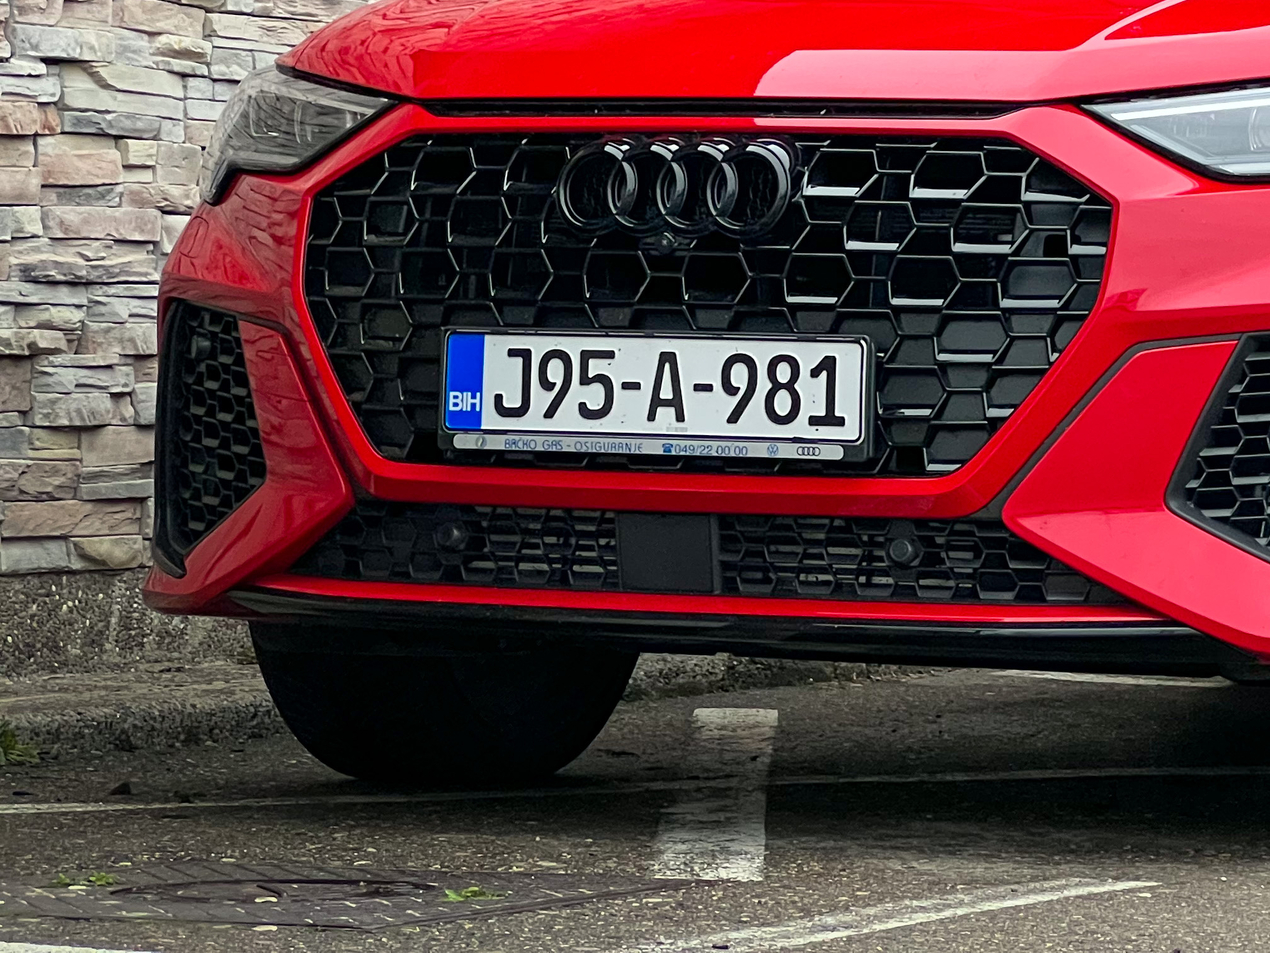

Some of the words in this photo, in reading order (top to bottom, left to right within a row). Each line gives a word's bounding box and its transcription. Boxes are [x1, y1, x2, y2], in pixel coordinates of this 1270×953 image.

[493, 348, 847, 428] J95-A-981
[449, 391, 481, 412] BIH
[542, 439, 563, 450] GAS
